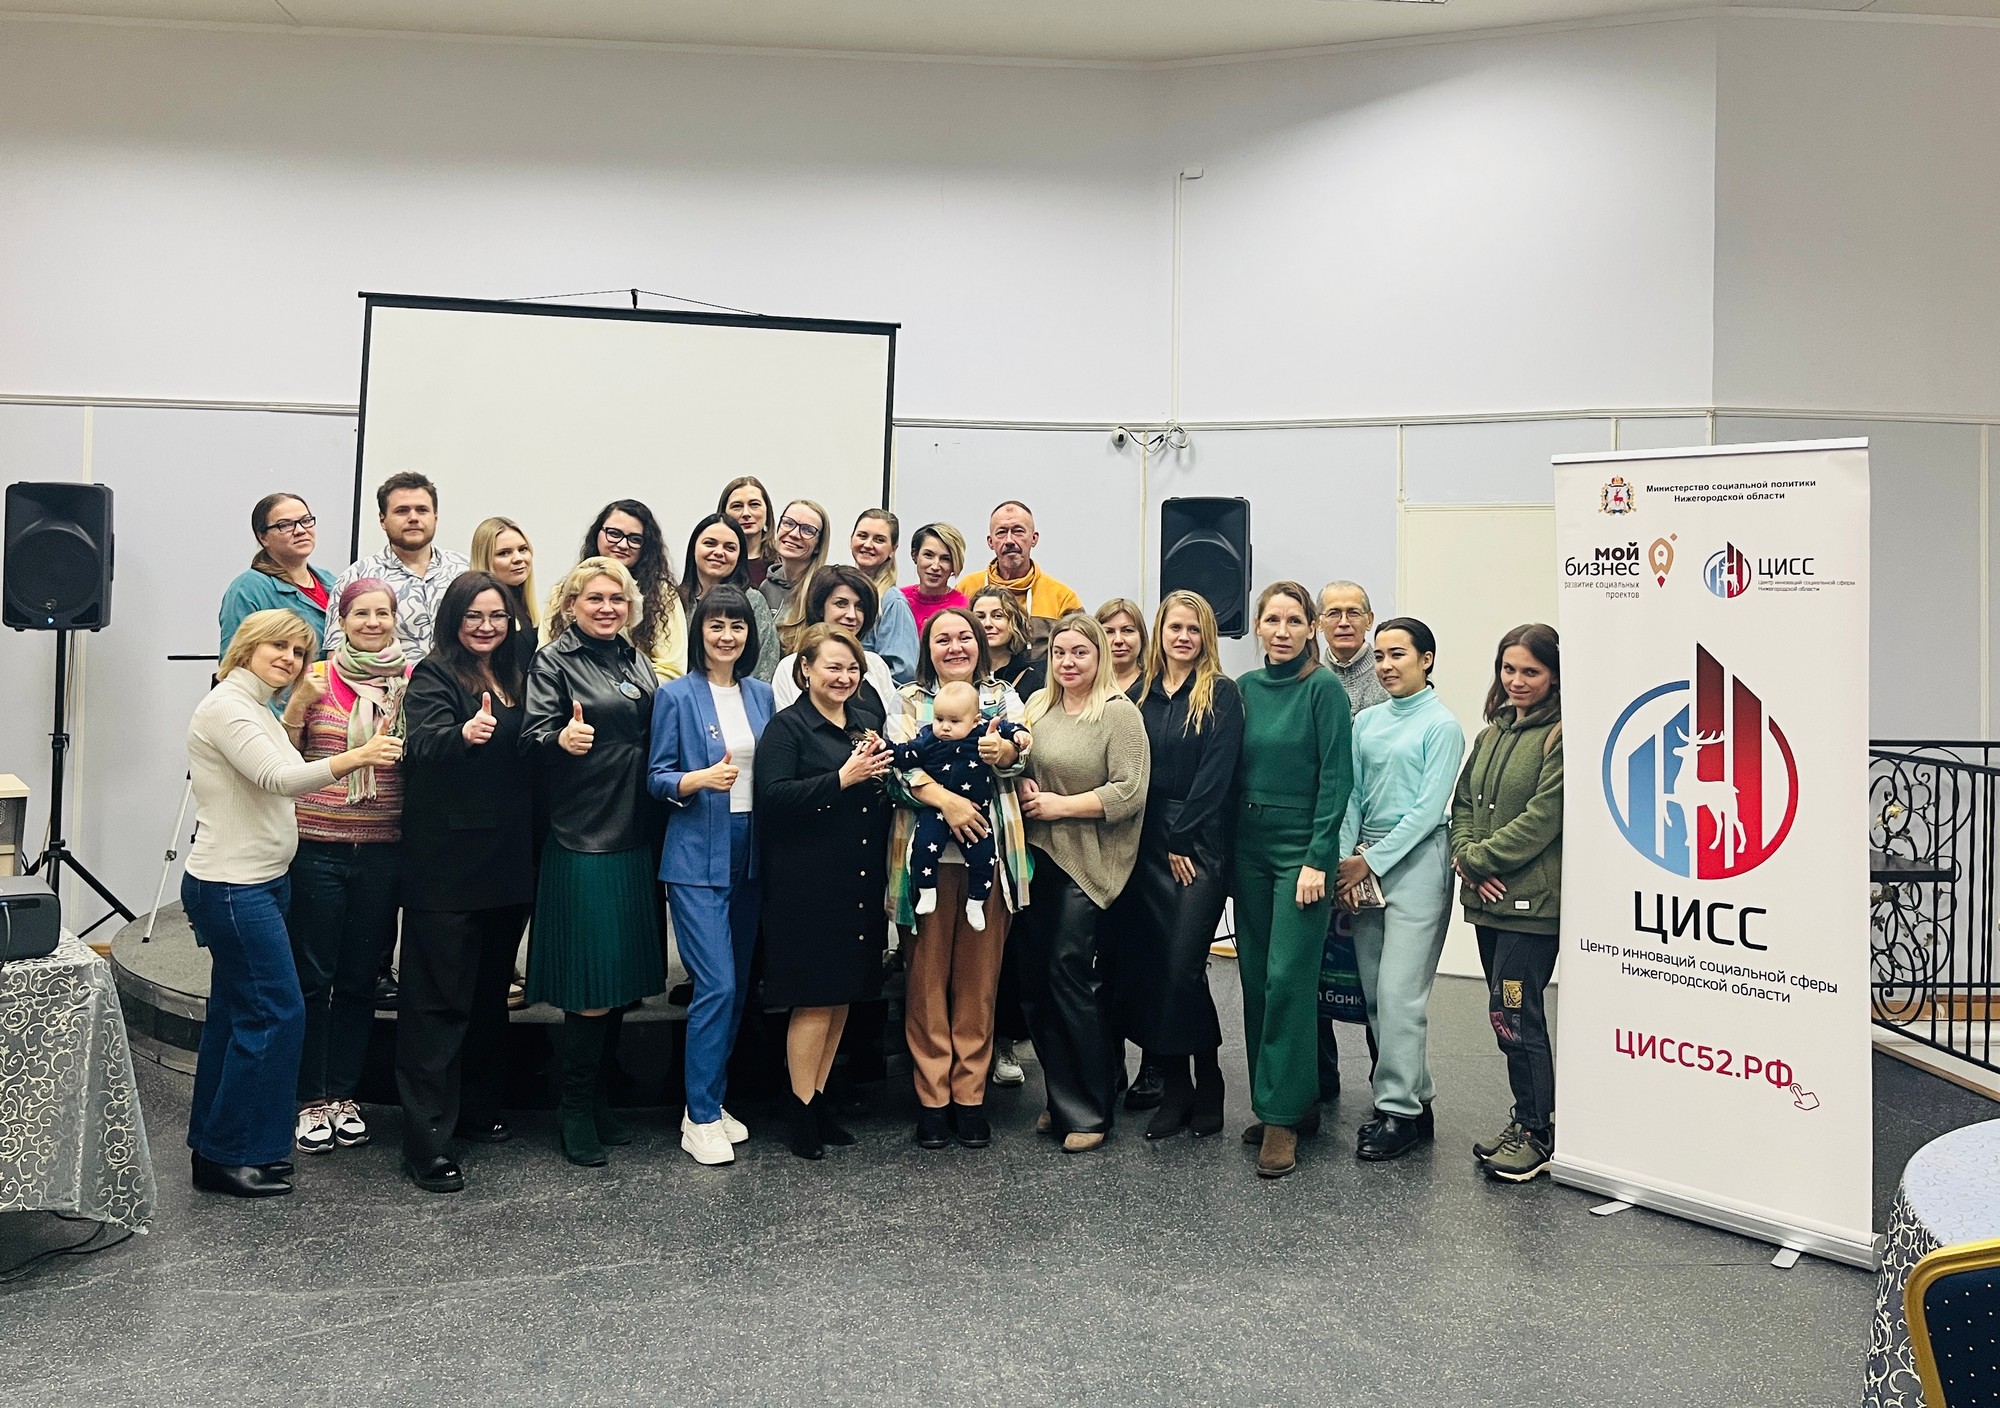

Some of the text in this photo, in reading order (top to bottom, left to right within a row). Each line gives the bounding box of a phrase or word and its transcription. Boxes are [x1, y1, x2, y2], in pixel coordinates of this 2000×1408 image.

[1646, 480, 1816, 493] Министерство социальной политики
[1674, 492, 1785, 503] Нижегородской области
[1595, 541, 1639, 561] мой
[1565, 556, 1640, 576] бизнес
[1758, 558, 1815, 579] ЦИСС
[1605, 591, 1640, 600] проектов
[1634, 890, 1768, 951] ЦИСС
[1580, 938, 1838, 994] Центр инноваций социальной сферы
[1621, 962, 1791, 1003] Нижегородской области
[1325, 990, 1362, 1005] банк
[1615, 1028, 1793, 1089] ЦИСС52.РФ
